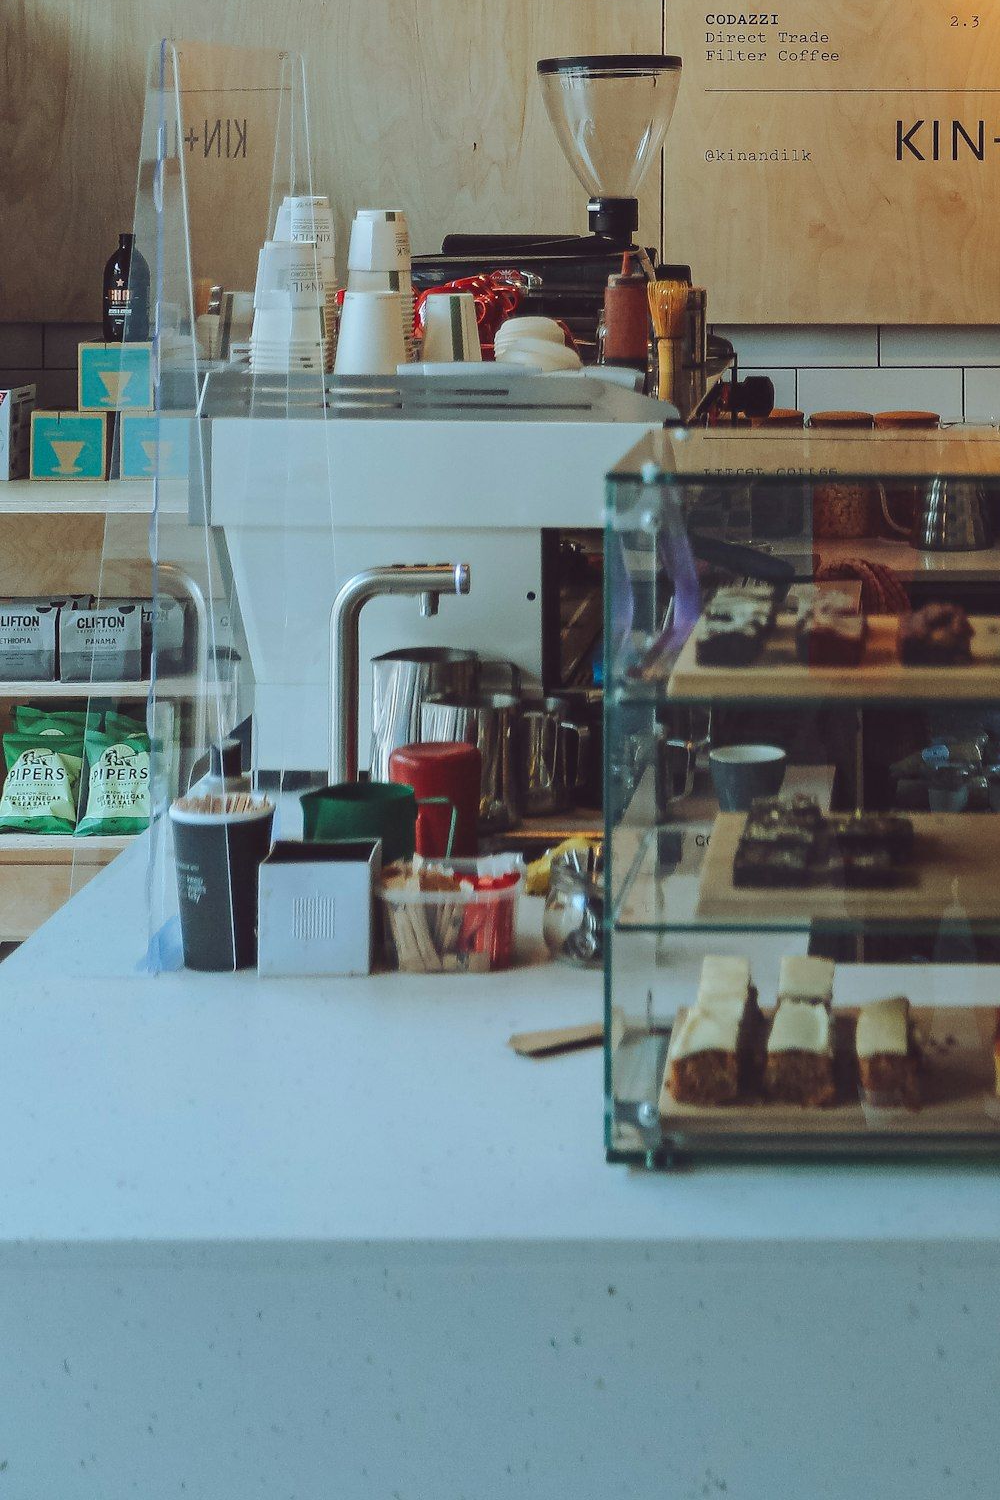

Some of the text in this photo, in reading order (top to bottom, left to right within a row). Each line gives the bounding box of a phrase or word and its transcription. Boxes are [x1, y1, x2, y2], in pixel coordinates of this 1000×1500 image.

[706, 14, 978, 28] CODAZZI 2.3
[706, 32, 828, 43] Direct Trade
[706, 50, 839, 61] Filter Coffee
[705, 149, 811, 162] @kinandilk
[0, 616, 40, 627] LIFTON
[76, 616, 125, 629] CLIFTON
